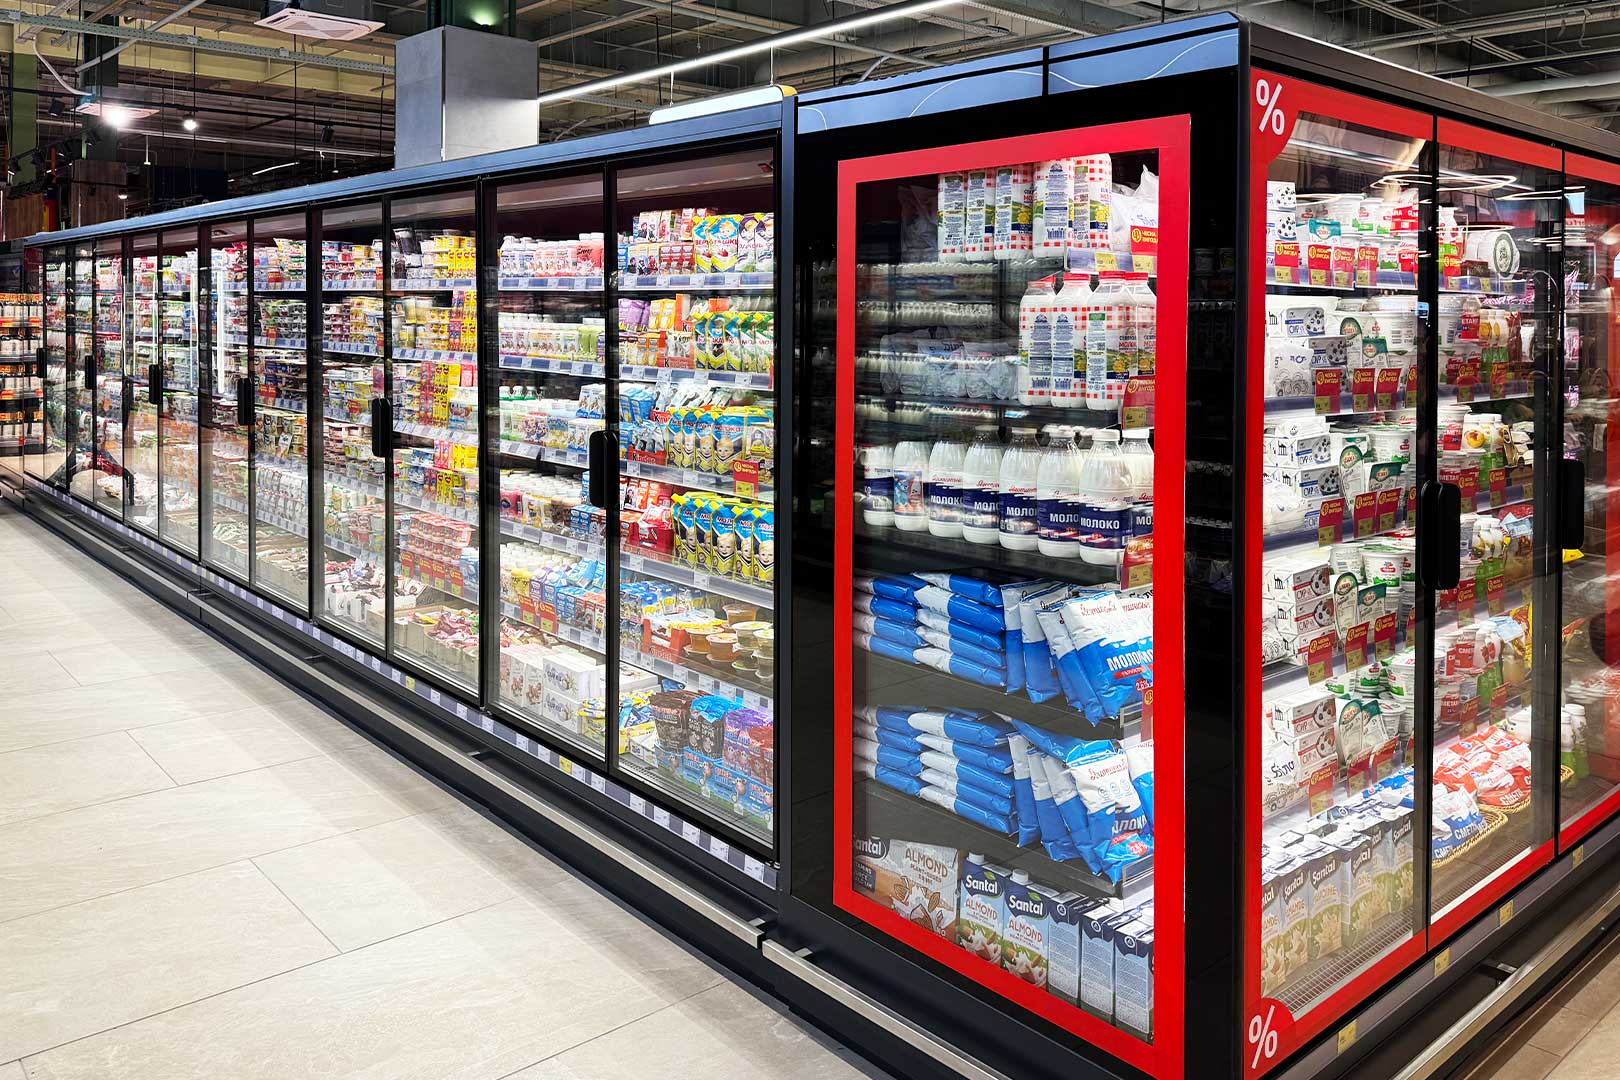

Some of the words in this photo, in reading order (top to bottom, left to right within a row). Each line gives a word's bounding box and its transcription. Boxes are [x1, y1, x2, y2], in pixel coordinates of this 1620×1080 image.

[1256, 79, 1285, 136] %
[1080, 517, 1120, 530] МОЛОКО
[905, 847, 949, 878] ALMOND
[1312, 858, 1336, 886] Santal
[965, 874, 999, 895] Santal
[1284, 871, 1304, 900] Santal
[965, 898, 999, 921] ALMOND
[1009, 895, 1044, 916] Santal
[1008, 919, 1043, 943] ALMOND
[1248, 1004, 1278, 1070] %
